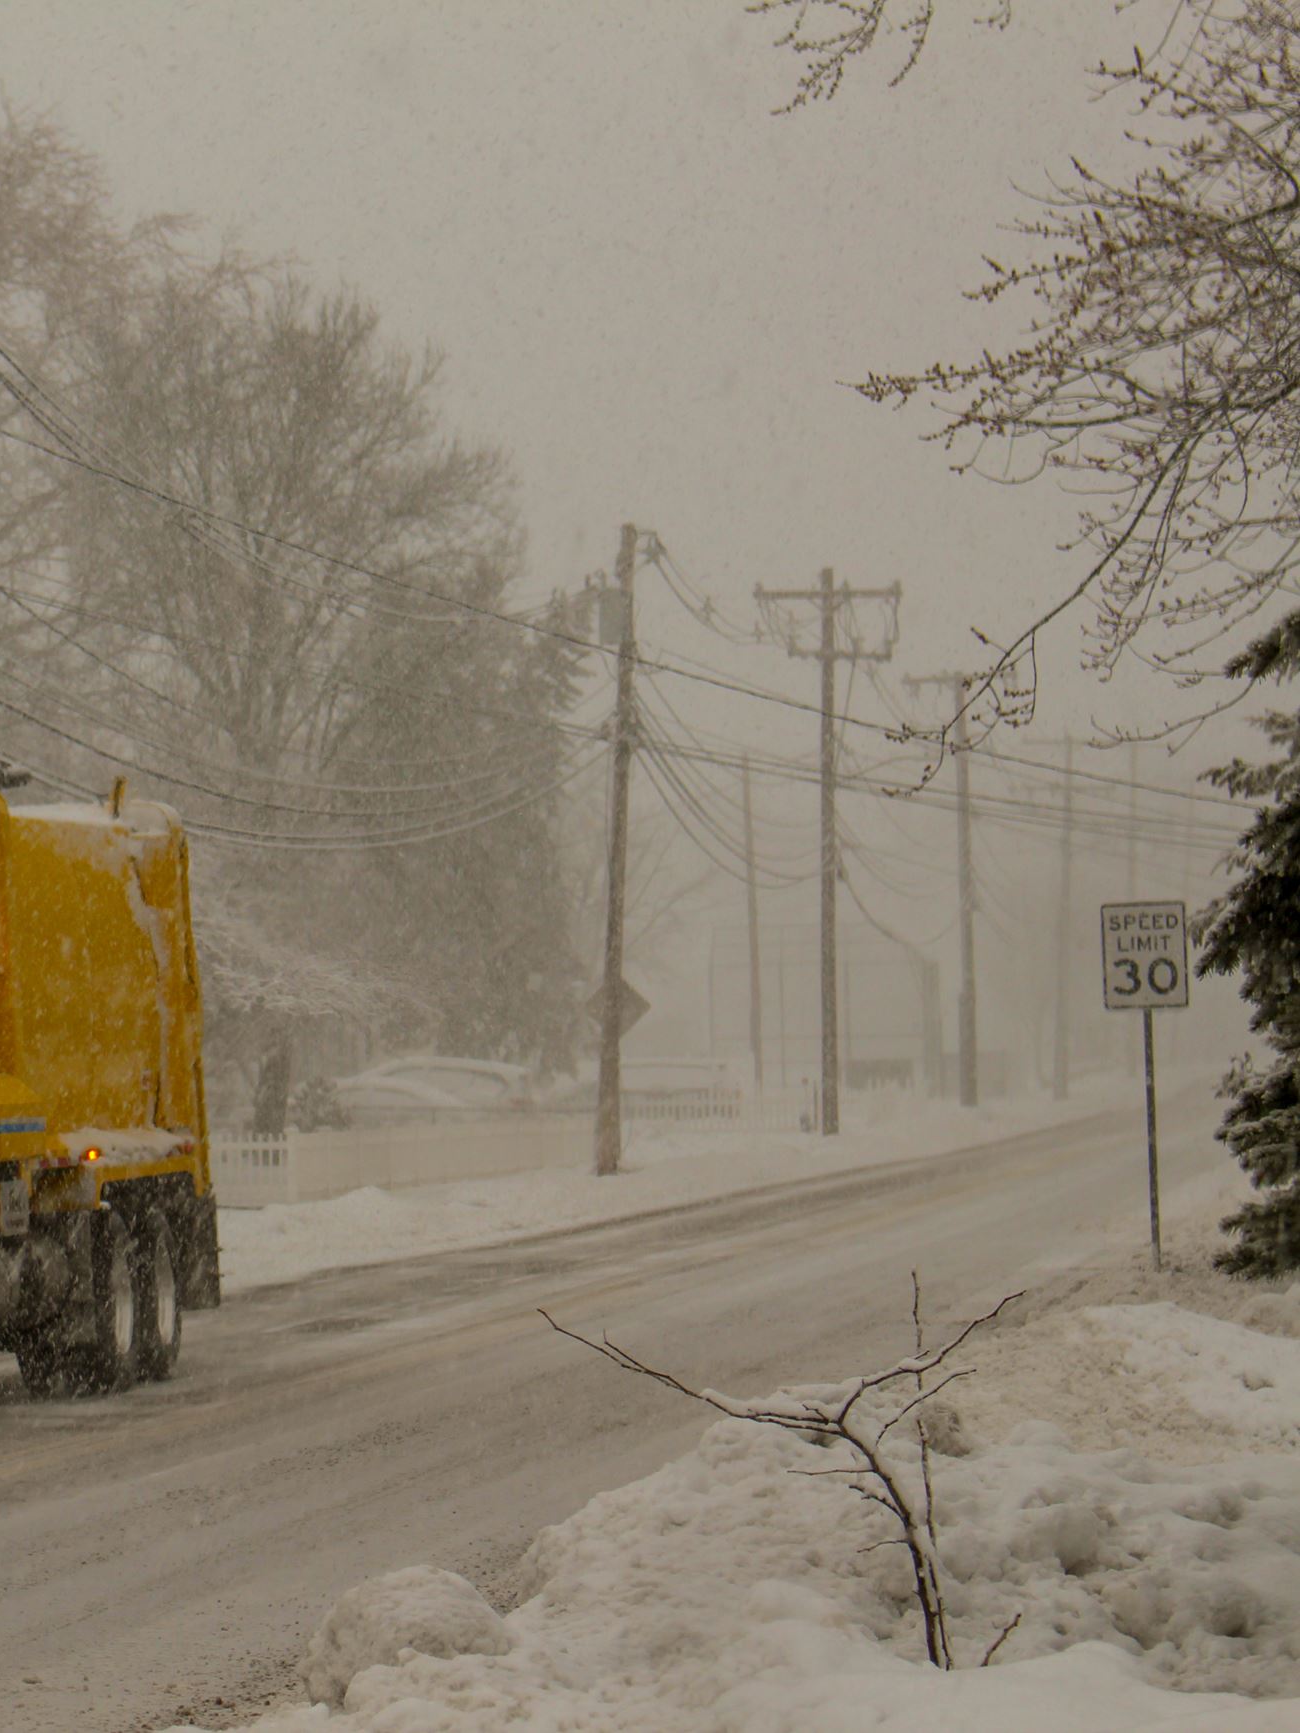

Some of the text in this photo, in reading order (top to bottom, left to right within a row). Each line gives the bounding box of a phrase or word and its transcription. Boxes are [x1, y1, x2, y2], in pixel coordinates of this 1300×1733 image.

[1109, 912, 1178, 931] SPEED
[1117, 935, 1170, 952] LIMIT
[1113, 957, 1178, 996] 30
